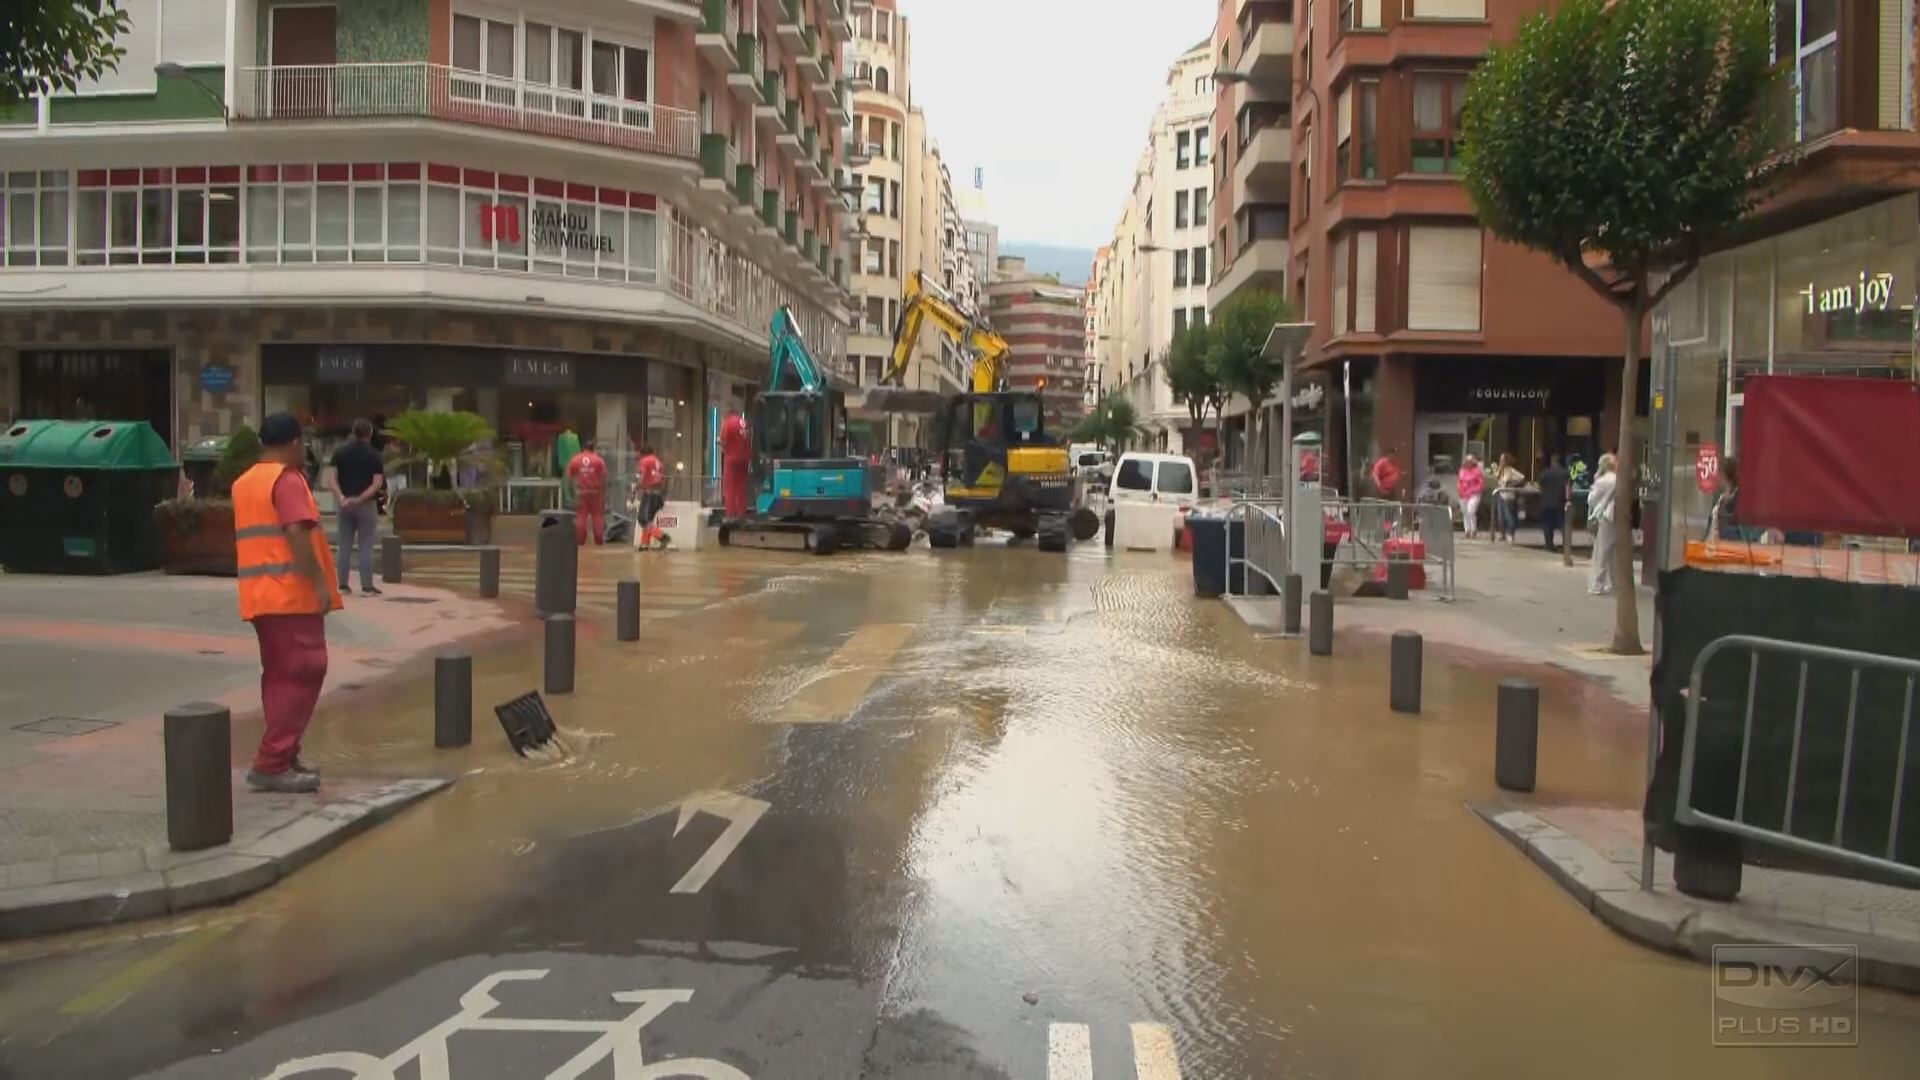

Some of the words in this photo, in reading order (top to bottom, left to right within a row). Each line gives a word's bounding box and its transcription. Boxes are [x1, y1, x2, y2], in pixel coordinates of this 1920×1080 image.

[531, 208, 588, 231] MAHOU
[1820, 288, 1852, 312] am
[1855, 271, 1893, 314] joy
